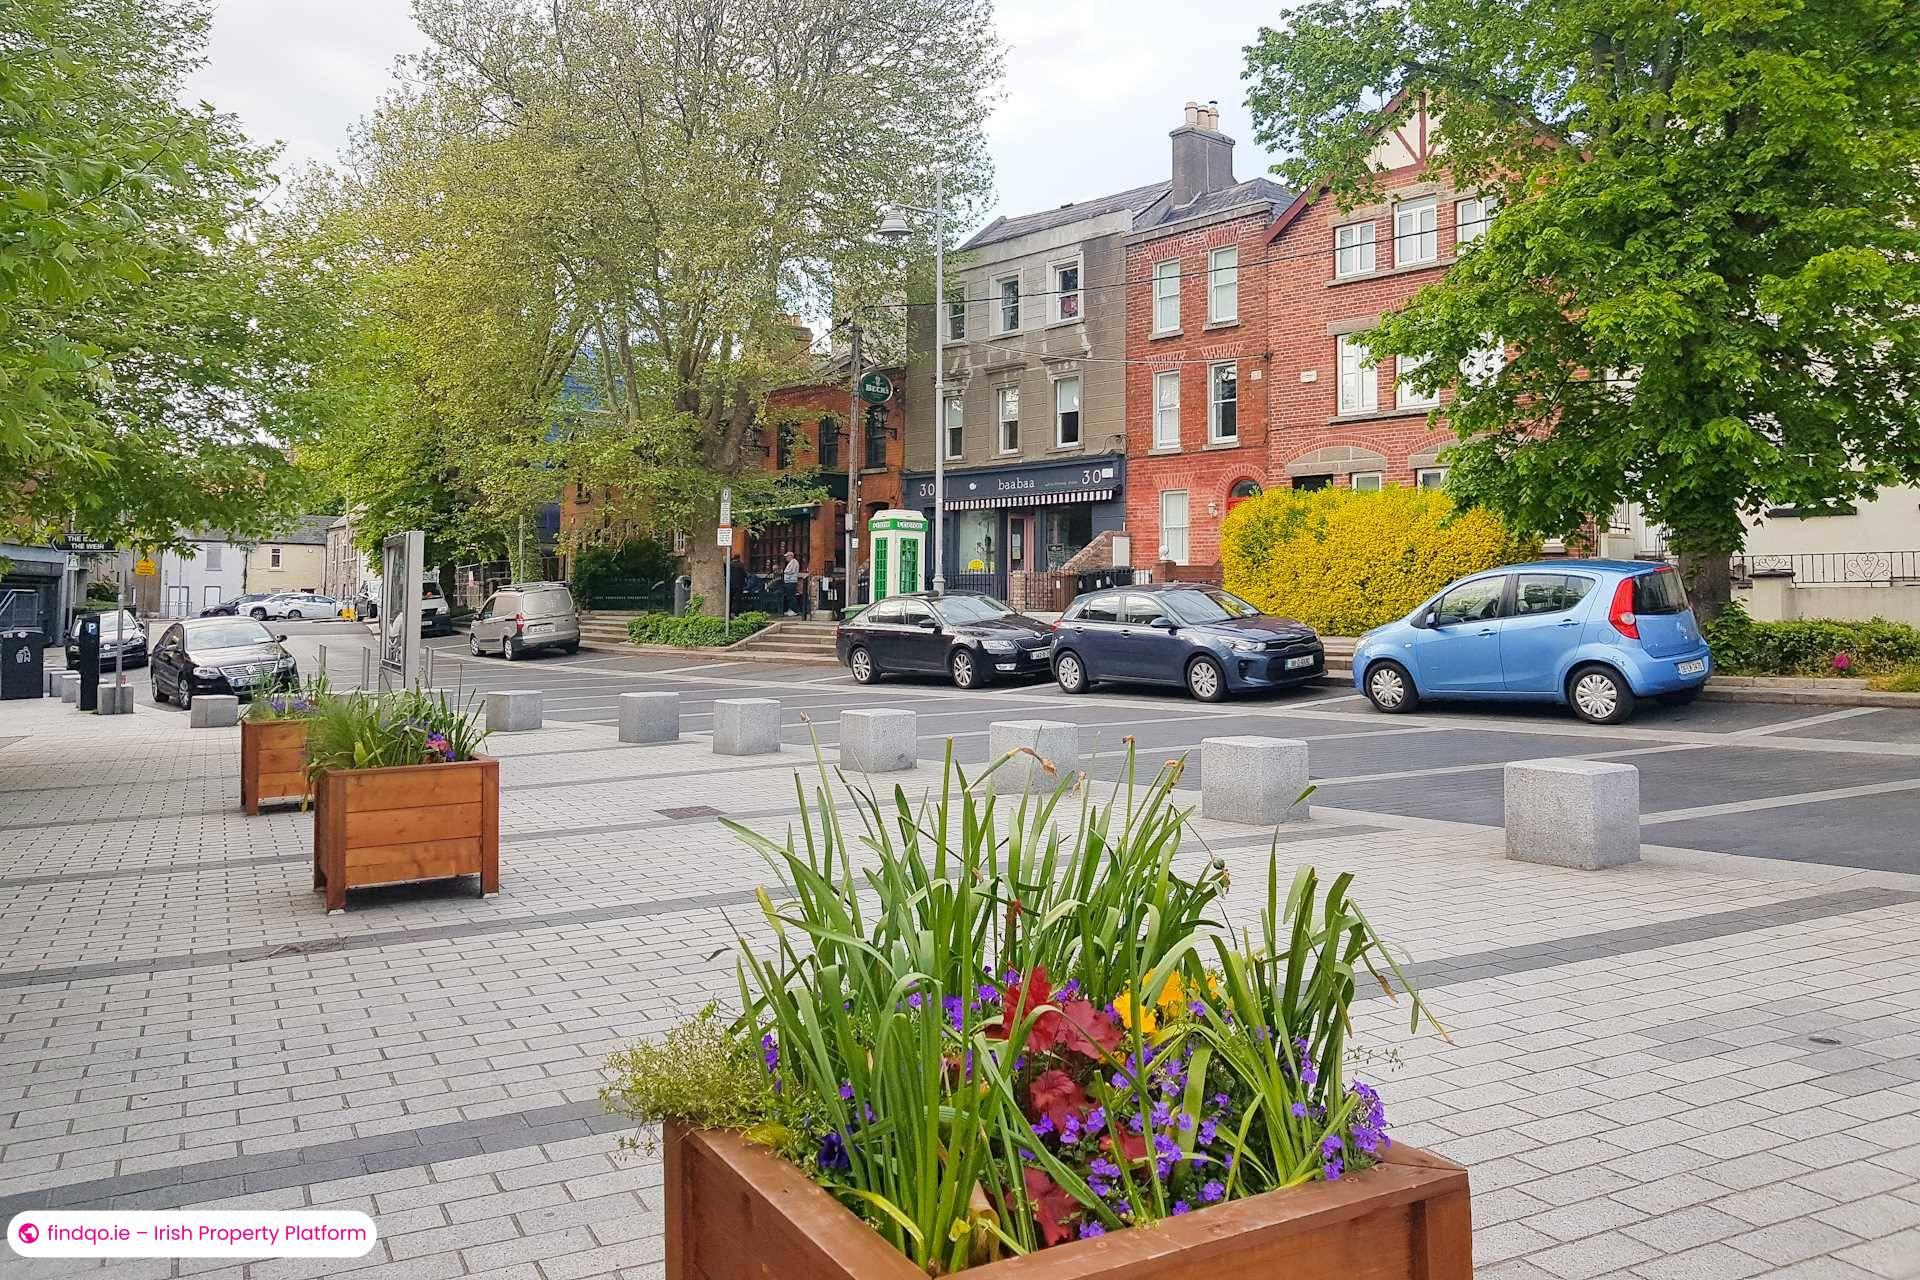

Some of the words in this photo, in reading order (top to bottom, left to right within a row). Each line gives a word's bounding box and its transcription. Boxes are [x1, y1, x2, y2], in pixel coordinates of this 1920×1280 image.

[997, 477, 1035, 490] baabaa
[1081, 469, 1101, 485] 30
[919, 483, 935, 497] 30
[88, 623, 96, 633] P
